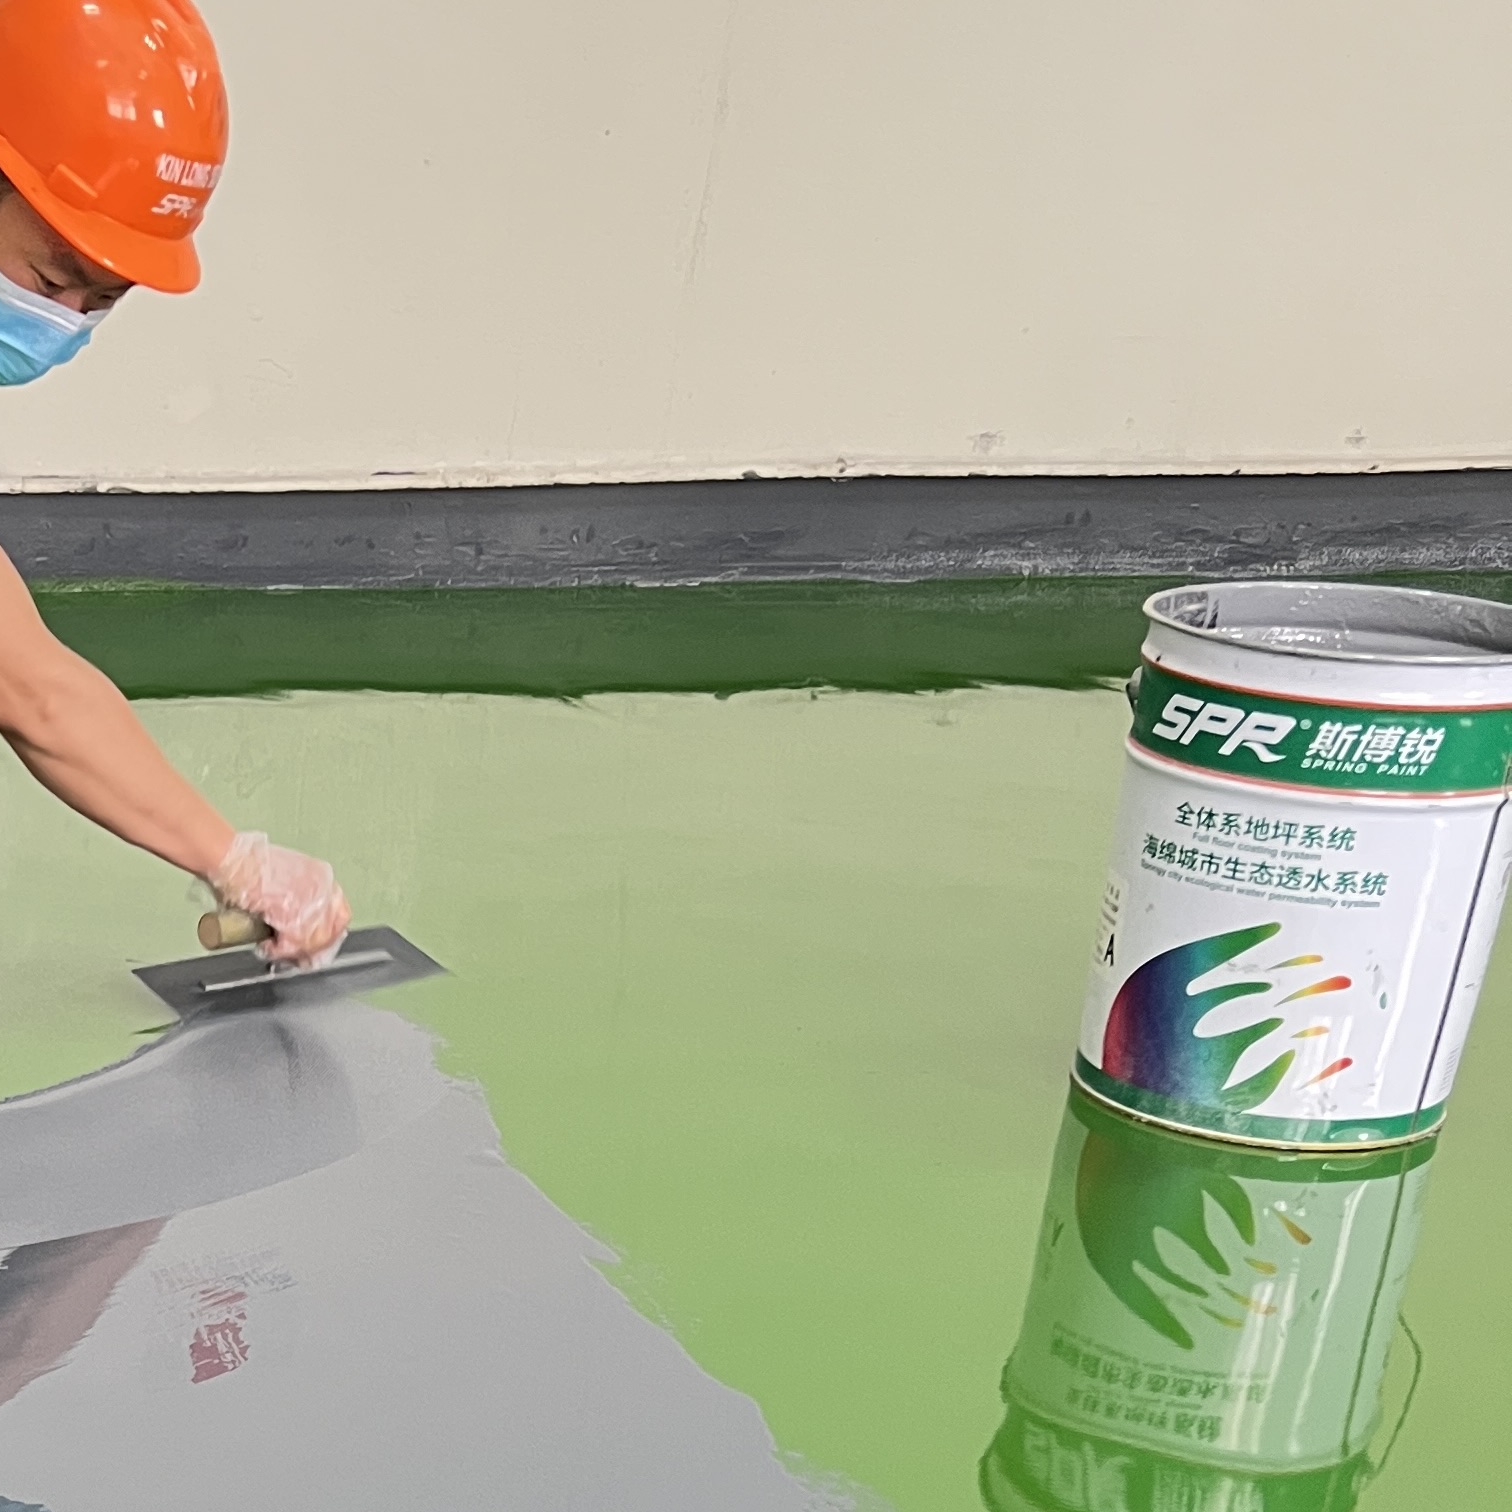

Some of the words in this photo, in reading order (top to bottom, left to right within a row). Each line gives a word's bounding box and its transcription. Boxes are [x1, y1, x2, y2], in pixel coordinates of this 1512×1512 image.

[1152, 693, 1297, 763] SPR
[1305, 721, 1446, 765] 斯博锐
[1300, 757, 1368, 774] SPRING
[1376, 763, 1431, 776] PAINT
[1175, 801, 1357, 851] 全体系地坪系统
[1142, 833, 1389, 896] 海绵城市生态透水系统
[1104, 933, 1115, 967] A
